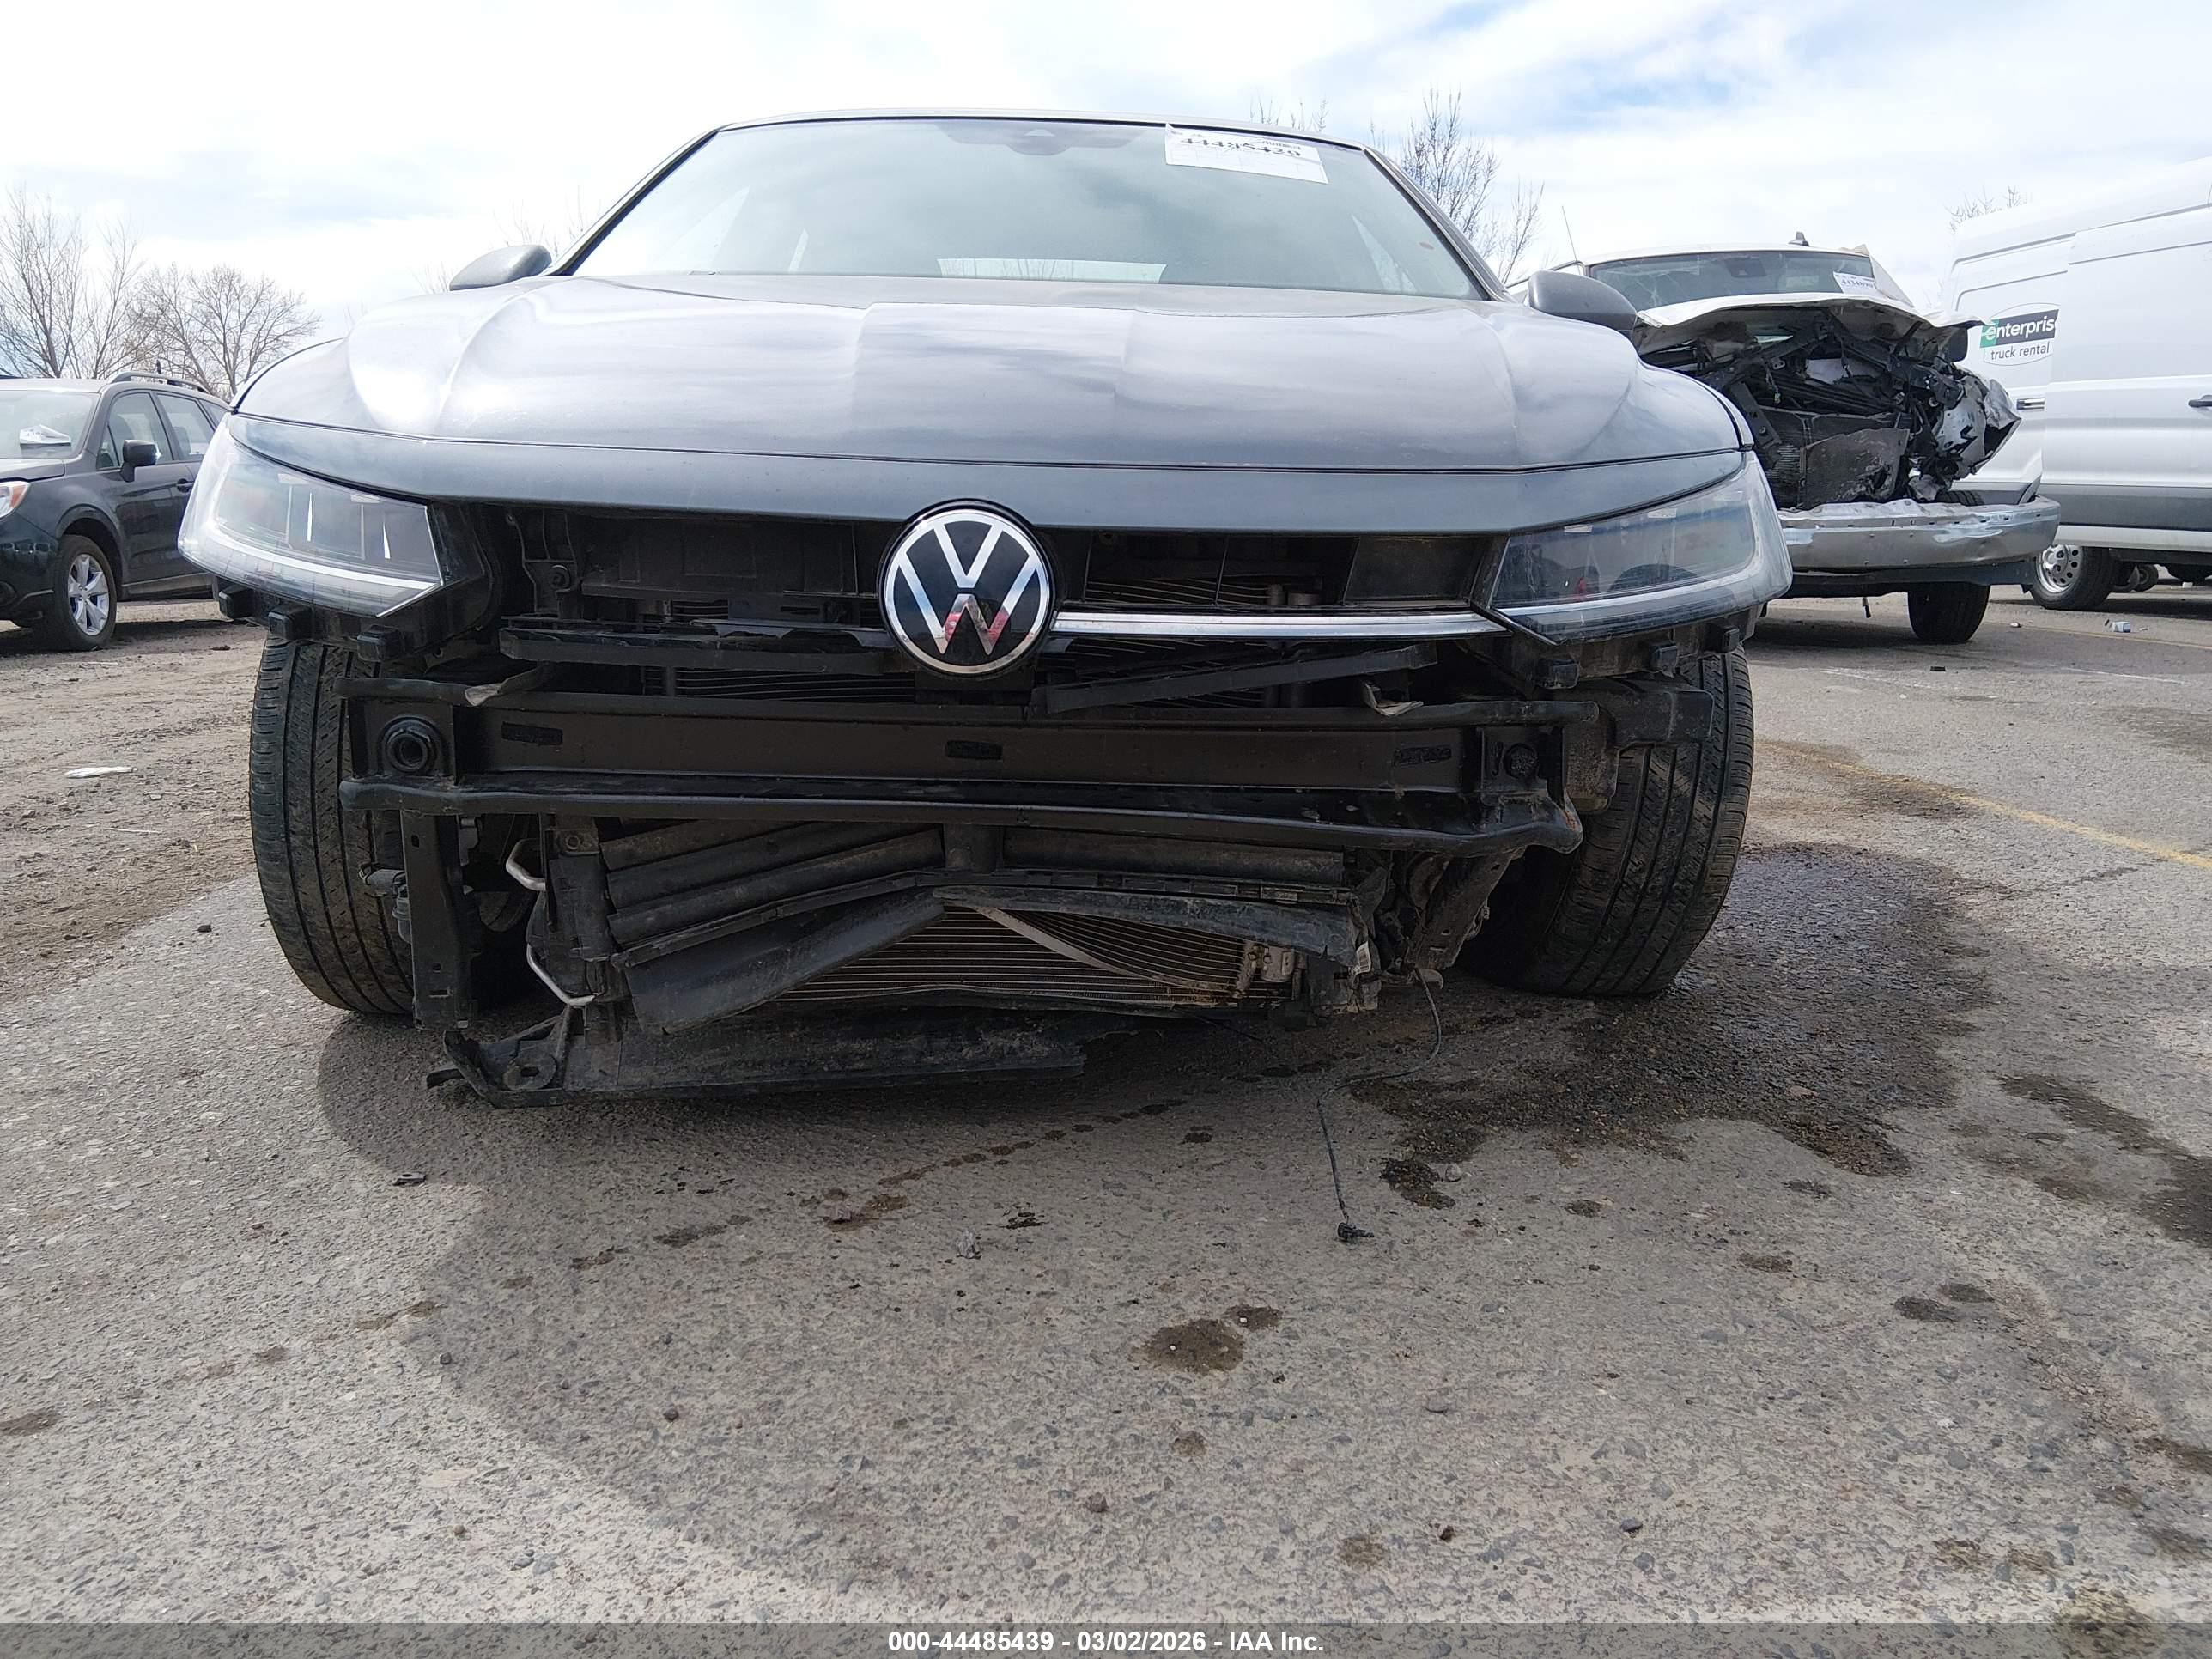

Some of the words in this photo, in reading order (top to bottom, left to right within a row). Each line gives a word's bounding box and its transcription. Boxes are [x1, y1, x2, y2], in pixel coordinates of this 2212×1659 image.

[1982, 315, 2057, 341] enterpris
[1990, 345, 2016, 360] truck
[2019, 341, 2051, 356] rental
